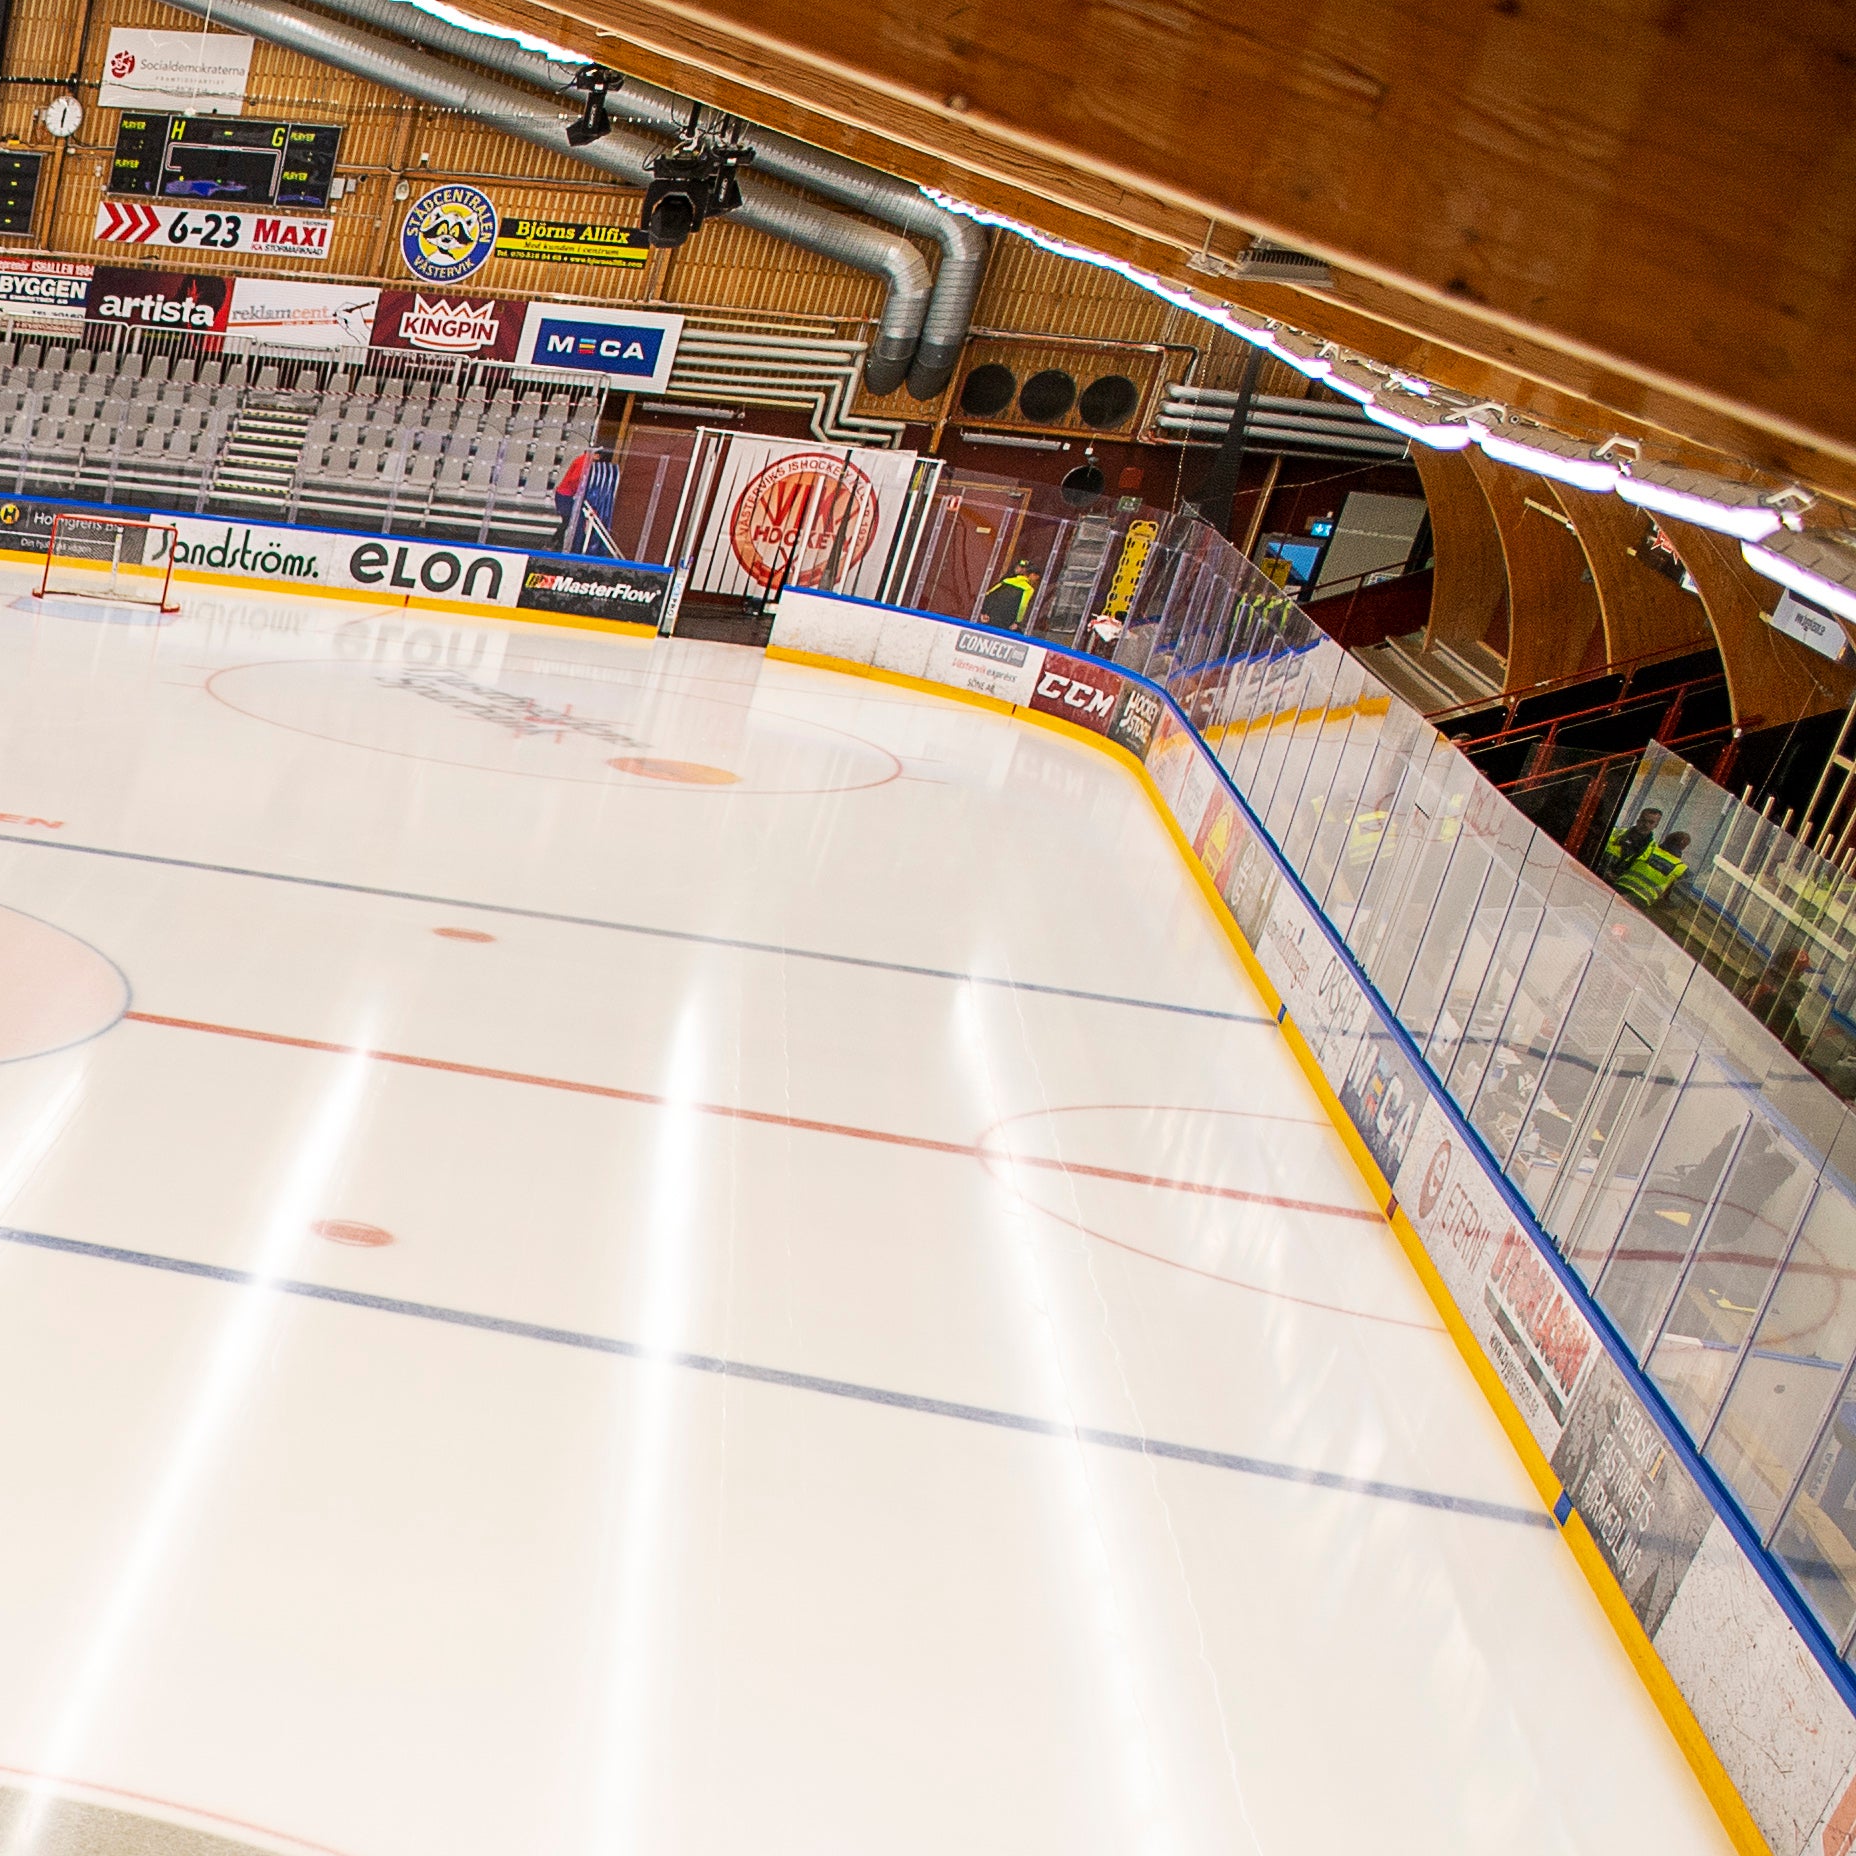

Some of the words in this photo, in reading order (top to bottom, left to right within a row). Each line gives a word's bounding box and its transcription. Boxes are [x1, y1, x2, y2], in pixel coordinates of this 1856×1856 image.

[139, 58, 247, 77] Socialdemokraterna
[171, 120, 186, 141] H
[271, 127, 286, 148] G
[168, 210, 242, 250] 6-23
[406, 188, 494, 244] STÄDCENTRALEN
[252, 217, 328, 248] MAXI
[515, 220, 576, 242] Björns
[579, 225, 630, 245] Allfix
[412, 255, 476, 280] VÄSTERVIK
[98, 293, 216, 328] artista
[403, 315, 495, 342] KINGPIN
[552, 574, 657, 604] MasterFlow
[958, 633, 1014, 663] CONNECT
[1036, 671, 1116, 719] CCM
